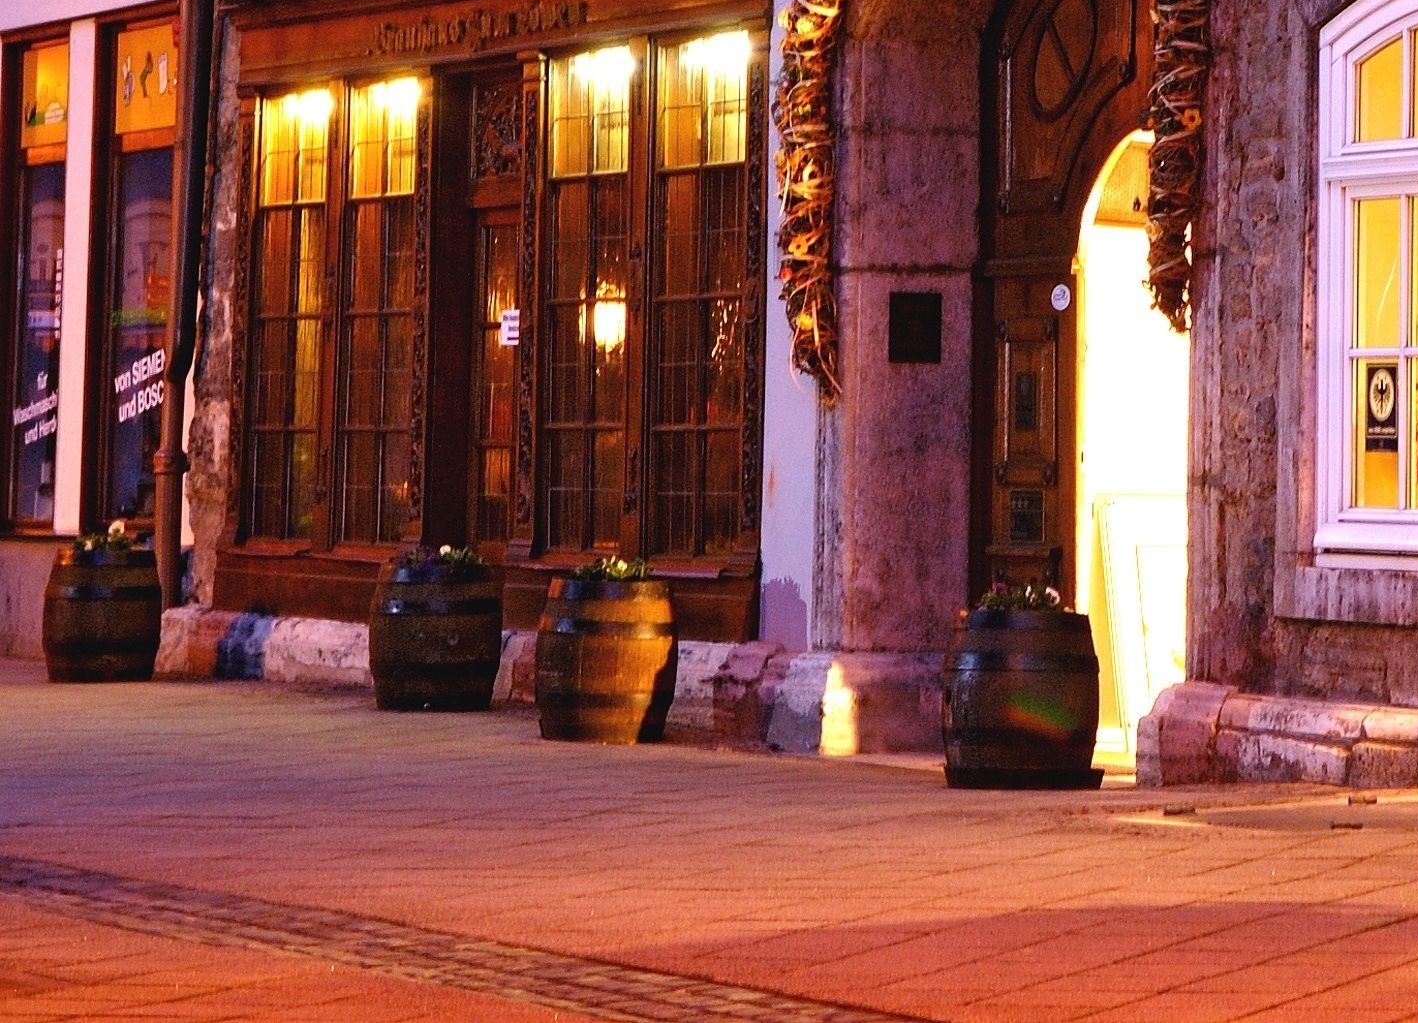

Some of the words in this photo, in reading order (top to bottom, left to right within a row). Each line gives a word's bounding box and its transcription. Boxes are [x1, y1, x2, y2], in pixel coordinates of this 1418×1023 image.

[114, 371, 131, 394] von
[119, 393, 137, 423] und
[137, 379, 164, 414] BOSC
